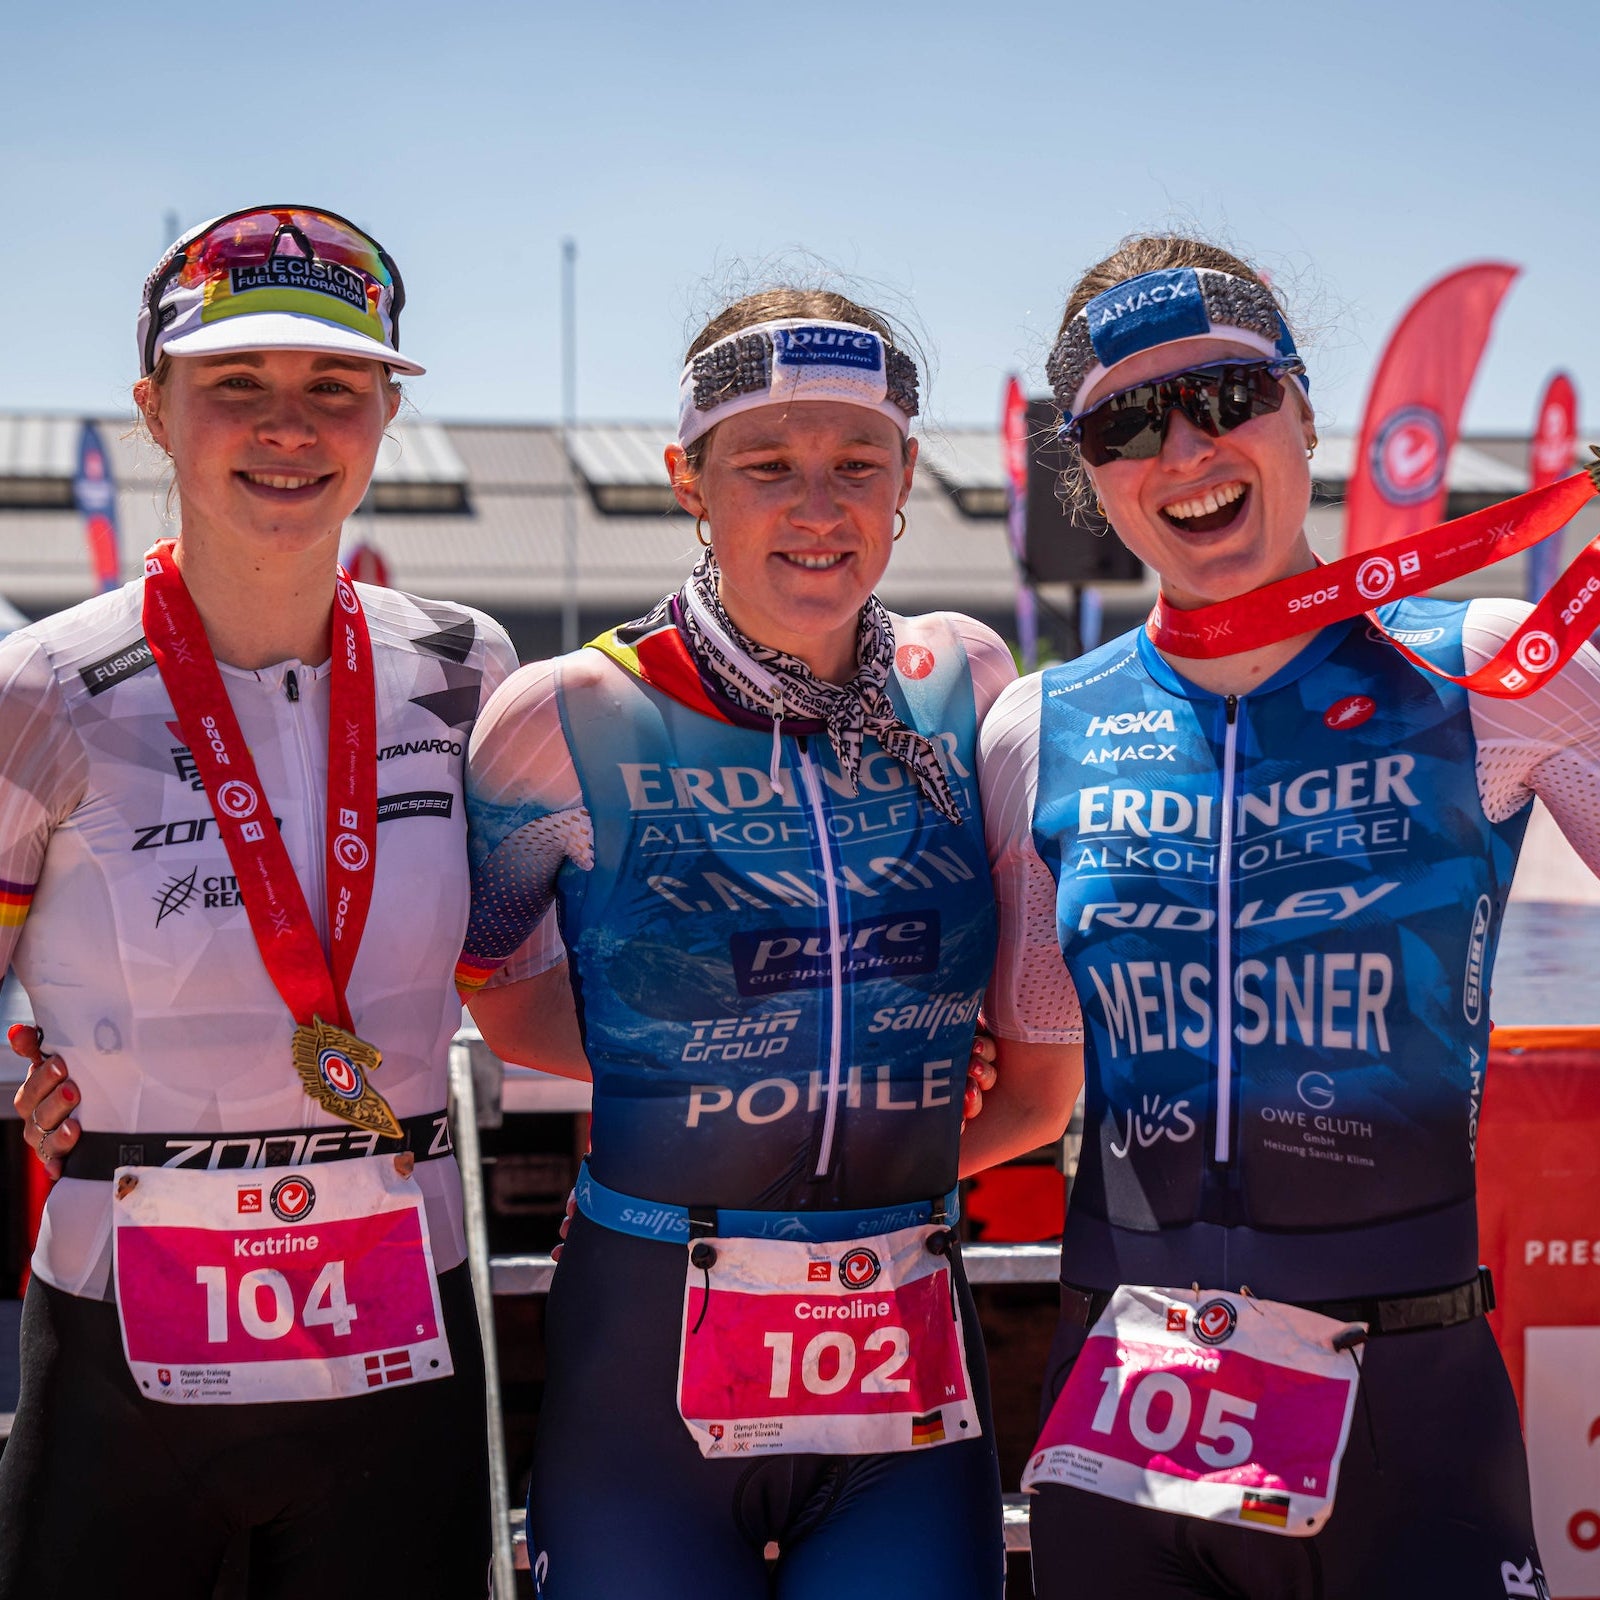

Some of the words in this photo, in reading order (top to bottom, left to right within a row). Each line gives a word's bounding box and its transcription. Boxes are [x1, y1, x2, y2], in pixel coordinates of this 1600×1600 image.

[239, 274, 274, 288] FUEL
[278, 274, 288, 284] &
[294, 275, 363, 305] HYDRATION
[1100, 281, 1187, 326] AMACX
[786, 332, 873, 350] pure
[1287, 585, 1339, 613] 2026
[1561, 576, 1600, 625] 2026
[94, 645, 152, 682] FUSION
[346, 624, 357, 672] 2026
[703, 636, 727, 667] FUEL
[1048, 682, 1083, 697] BLUE
[1085, 648, 1138, 685] SEVENTY
[202, 716, 230, 765] 2026
[1085, 709, 1176, 737] HOKA
[1081, 744, 1177, 765] AMACX
[377, 798, 450, 815] amicspeed
[1077, 755, 1421, 839] ERDINGER
[1076, 817, 1410, 875] ALKOHOLFREI
[335, 886, 351, 941] 2026
[1078, 882, 1402, 932] RIDLEY
[752, 921, 927, 971] pure
[1467, 913, 1485, 1008] ABUS
[868, 989, 980, 1040] sailfish
[1088, 953, 1393, 1059] MEISSNER
[686, 1059, 953, 1128] POHLE
[1469, 1046, 1481, 1162] AMACX
[1261, 1107, 1307, 1127] OWE
[1314, 1115, 1373, 1138] GLUTH
[1303, 1132, 1335, 1147] GmbH
[1264, 1139, 1306, 1157] Heizung
[1346, 1154, 1375, 1167] Klima
[234, 1233, 319, 1257] Katrine
[196, 1260, 358, 1343] 104
[794, 1300, 890, 1320] Caroline
[763, 1326, 911, 1399] 102
[945, 1384, 956, 1395] M
[760, 1422, 783, 1430] Training
[1091, 1365, 1258, 1469] 105
[1303, 1476, 1317, 1489] M
